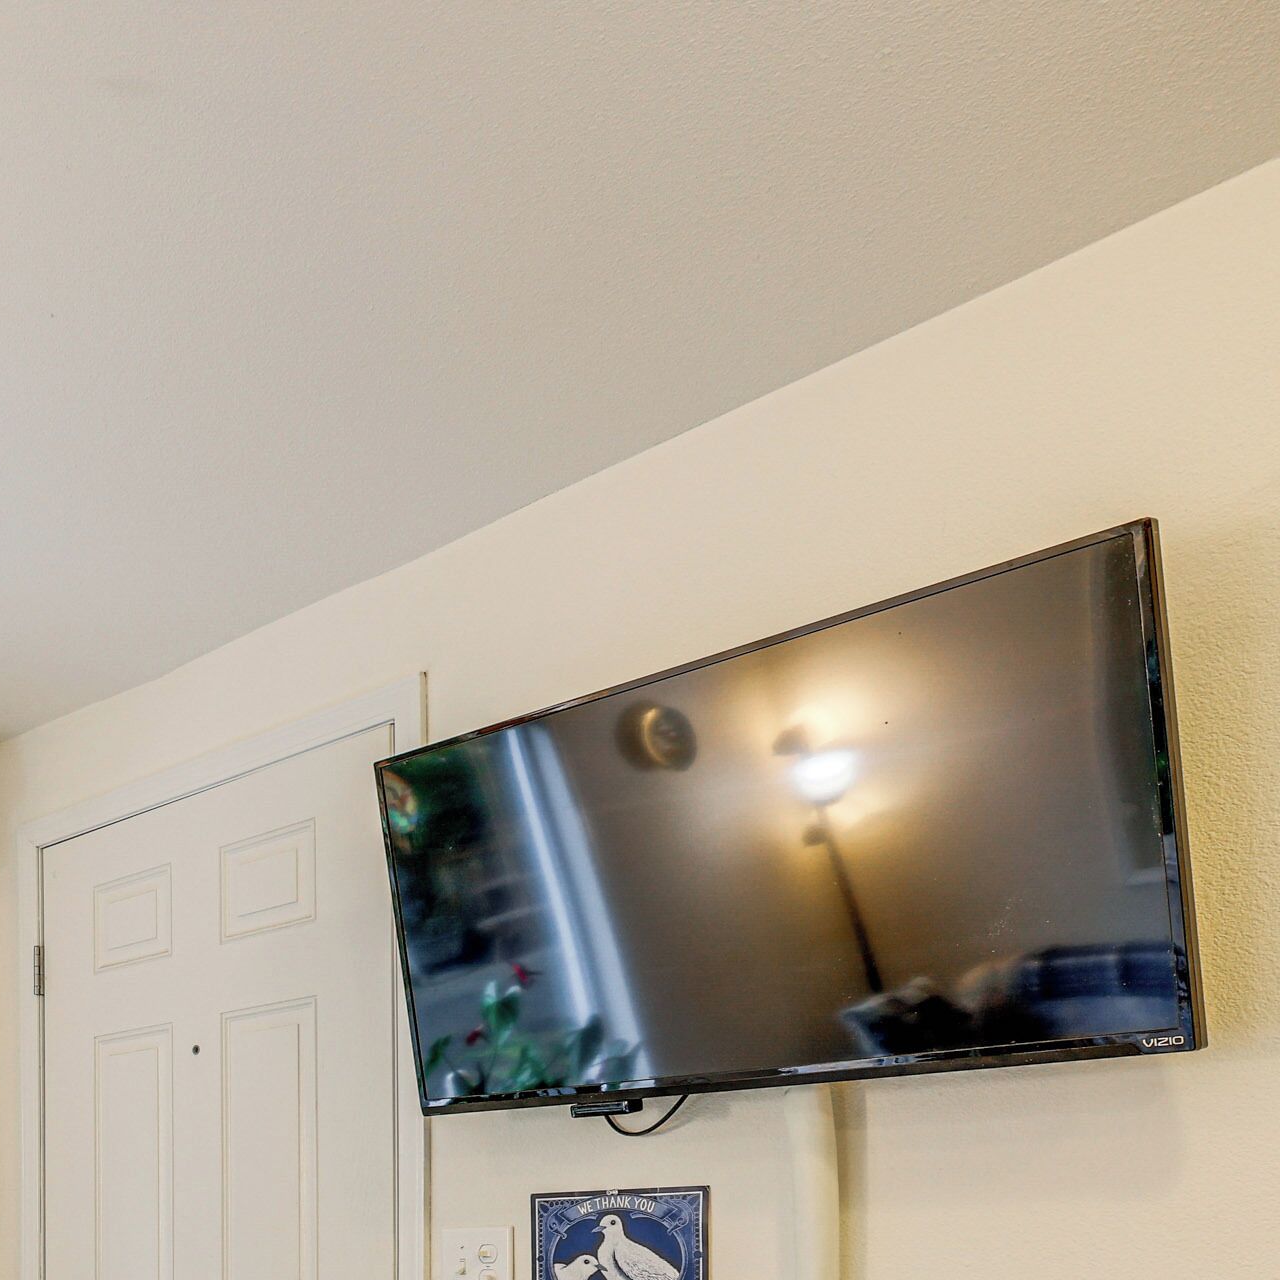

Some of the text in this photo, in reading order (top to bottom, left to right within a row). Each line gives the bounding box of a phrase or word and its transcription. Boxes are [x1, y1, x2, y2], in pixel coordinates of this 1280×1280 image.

[1142, 1035, 1184, 1048] VIZIO
[577, 1195, 656, 1215] WE THANK YOU
